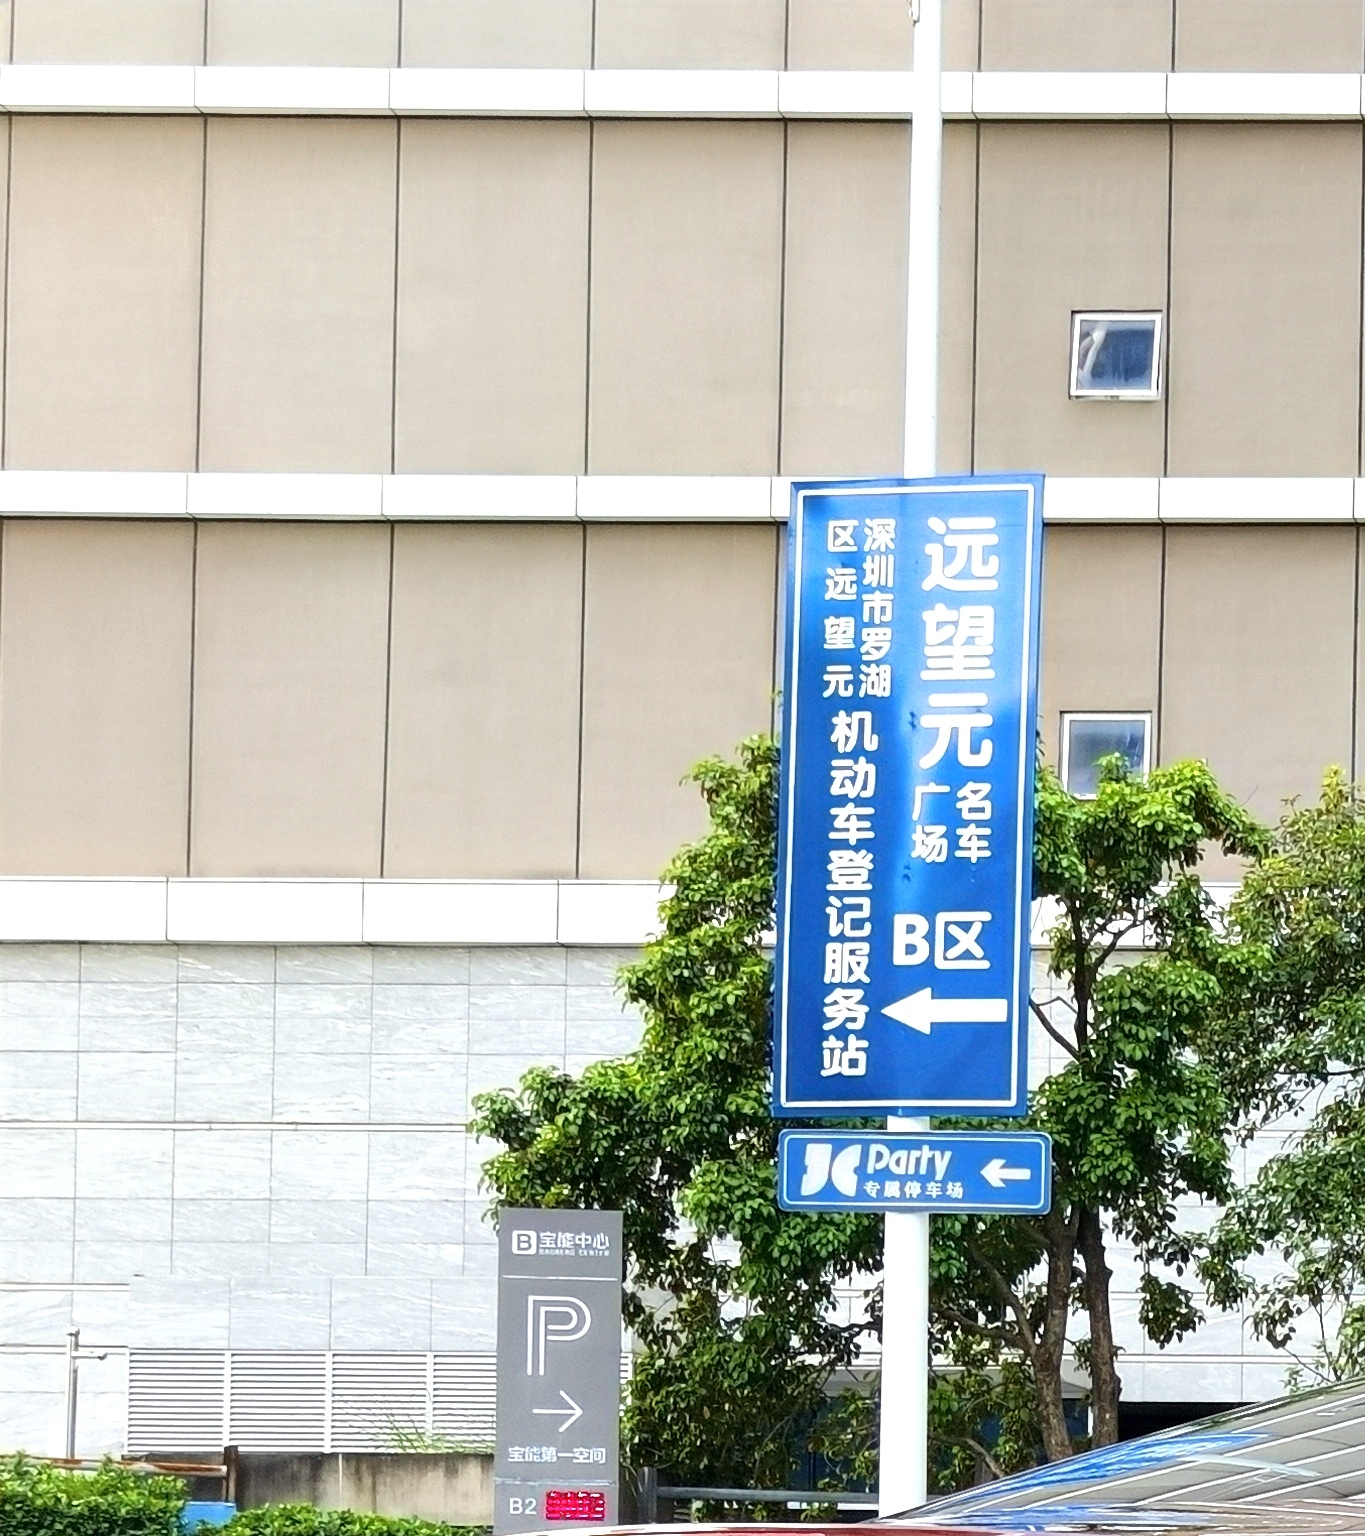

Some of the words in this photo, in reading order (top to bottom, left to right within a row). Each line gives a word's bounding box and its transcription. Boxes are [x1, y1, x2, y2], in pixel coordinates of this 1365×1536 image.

[823, 519, 858, 698] 区远望元
[859, 518, 896, 697] 深圳市罗湖
[919, 516, 999, 768] 远望元
[911, 782, 950, 863] 广场
[954, 781, 992, 863] 名车
[820, 710, 879, 1077] 机动车登记服务站
[893, 911, 992, 969] B区
[863, 1180, 963, 1199] 专属停车场
[866, 1143, 952, 1180] Party
[538, 1231, 610, 1249] 宝能中心
[527, 1295, 591, 1375] P
[507, 1446, 606, 1464] 宝能第一空间
[509, 1498, 537, 1515] B2
